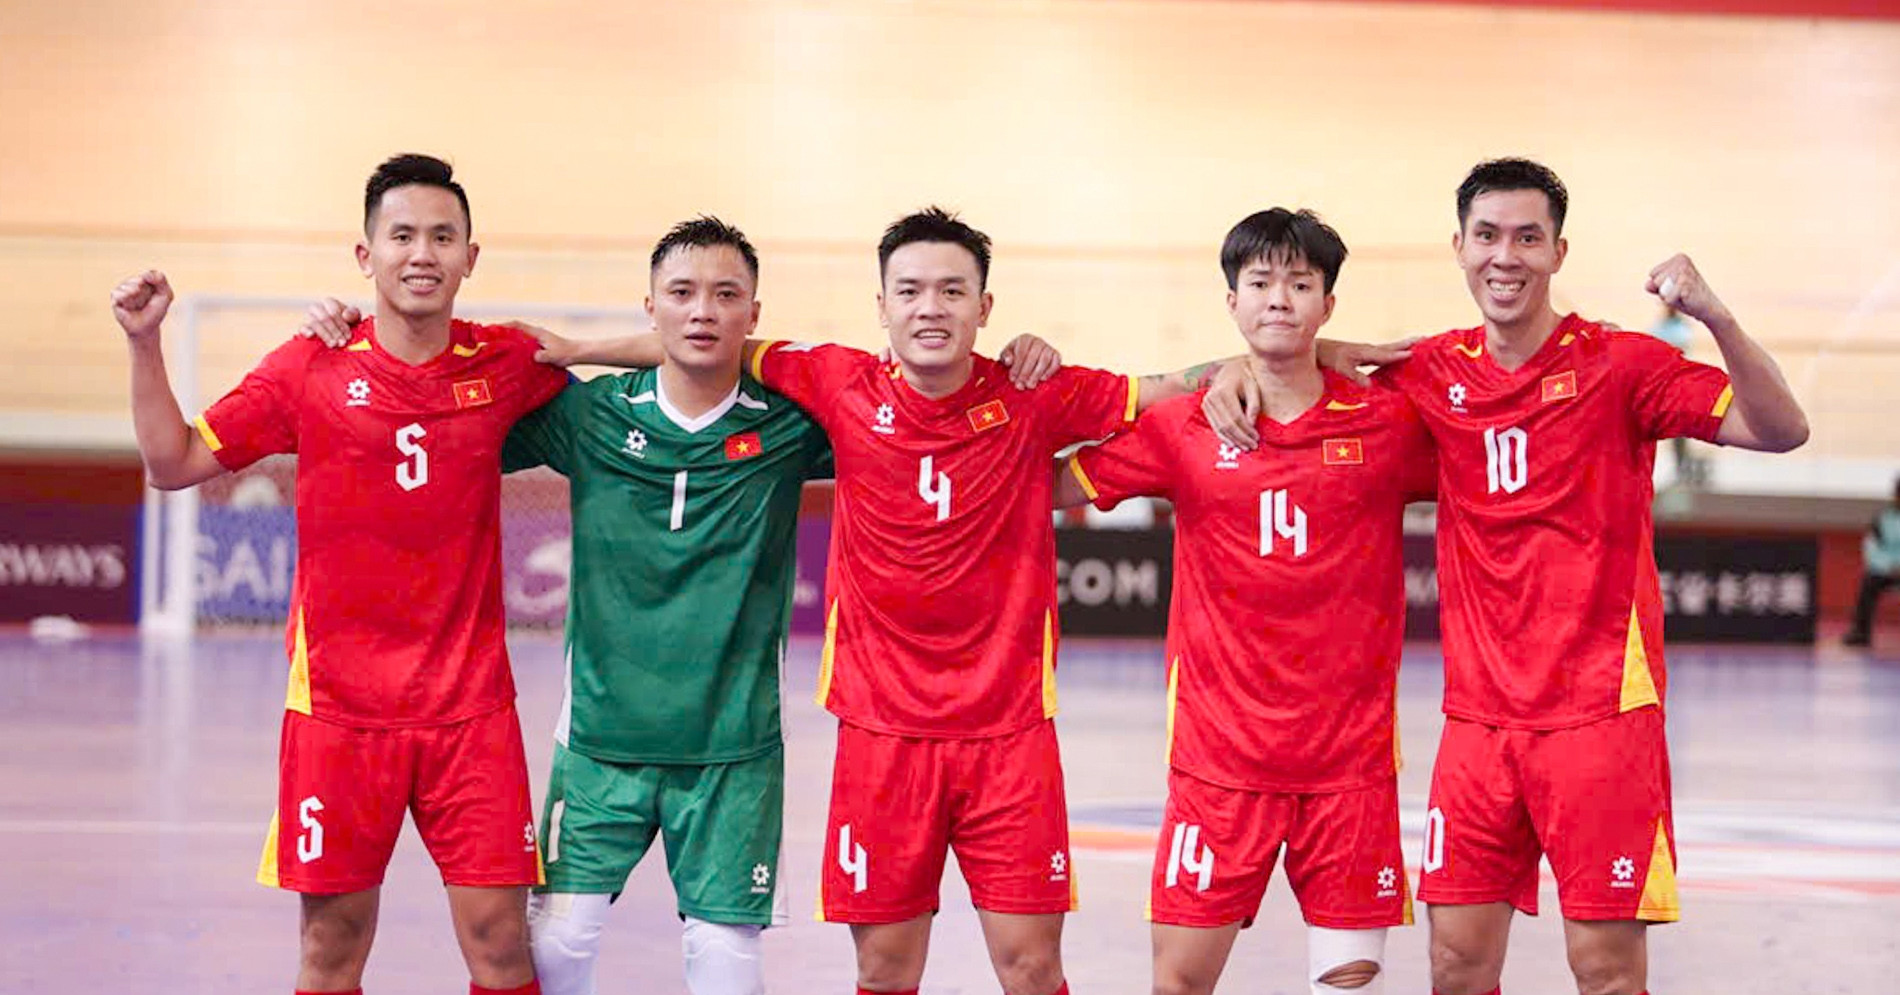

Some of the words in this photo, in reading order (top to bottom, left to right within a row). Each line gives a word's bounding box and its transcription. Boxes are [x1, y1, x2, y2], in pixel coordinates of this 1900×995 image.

[395, 422, 428, 491] 5
[918, 455, 951, 522] 4
[1484, 426, 1528, 494] 10
[670, 470, 688, 531] 1
[1259, 488, 1307, 557] 14
[297, 796, 324, 864] 5
[838, 824, 868, 893] 4
[1165, 821, 1215, 892] 14
